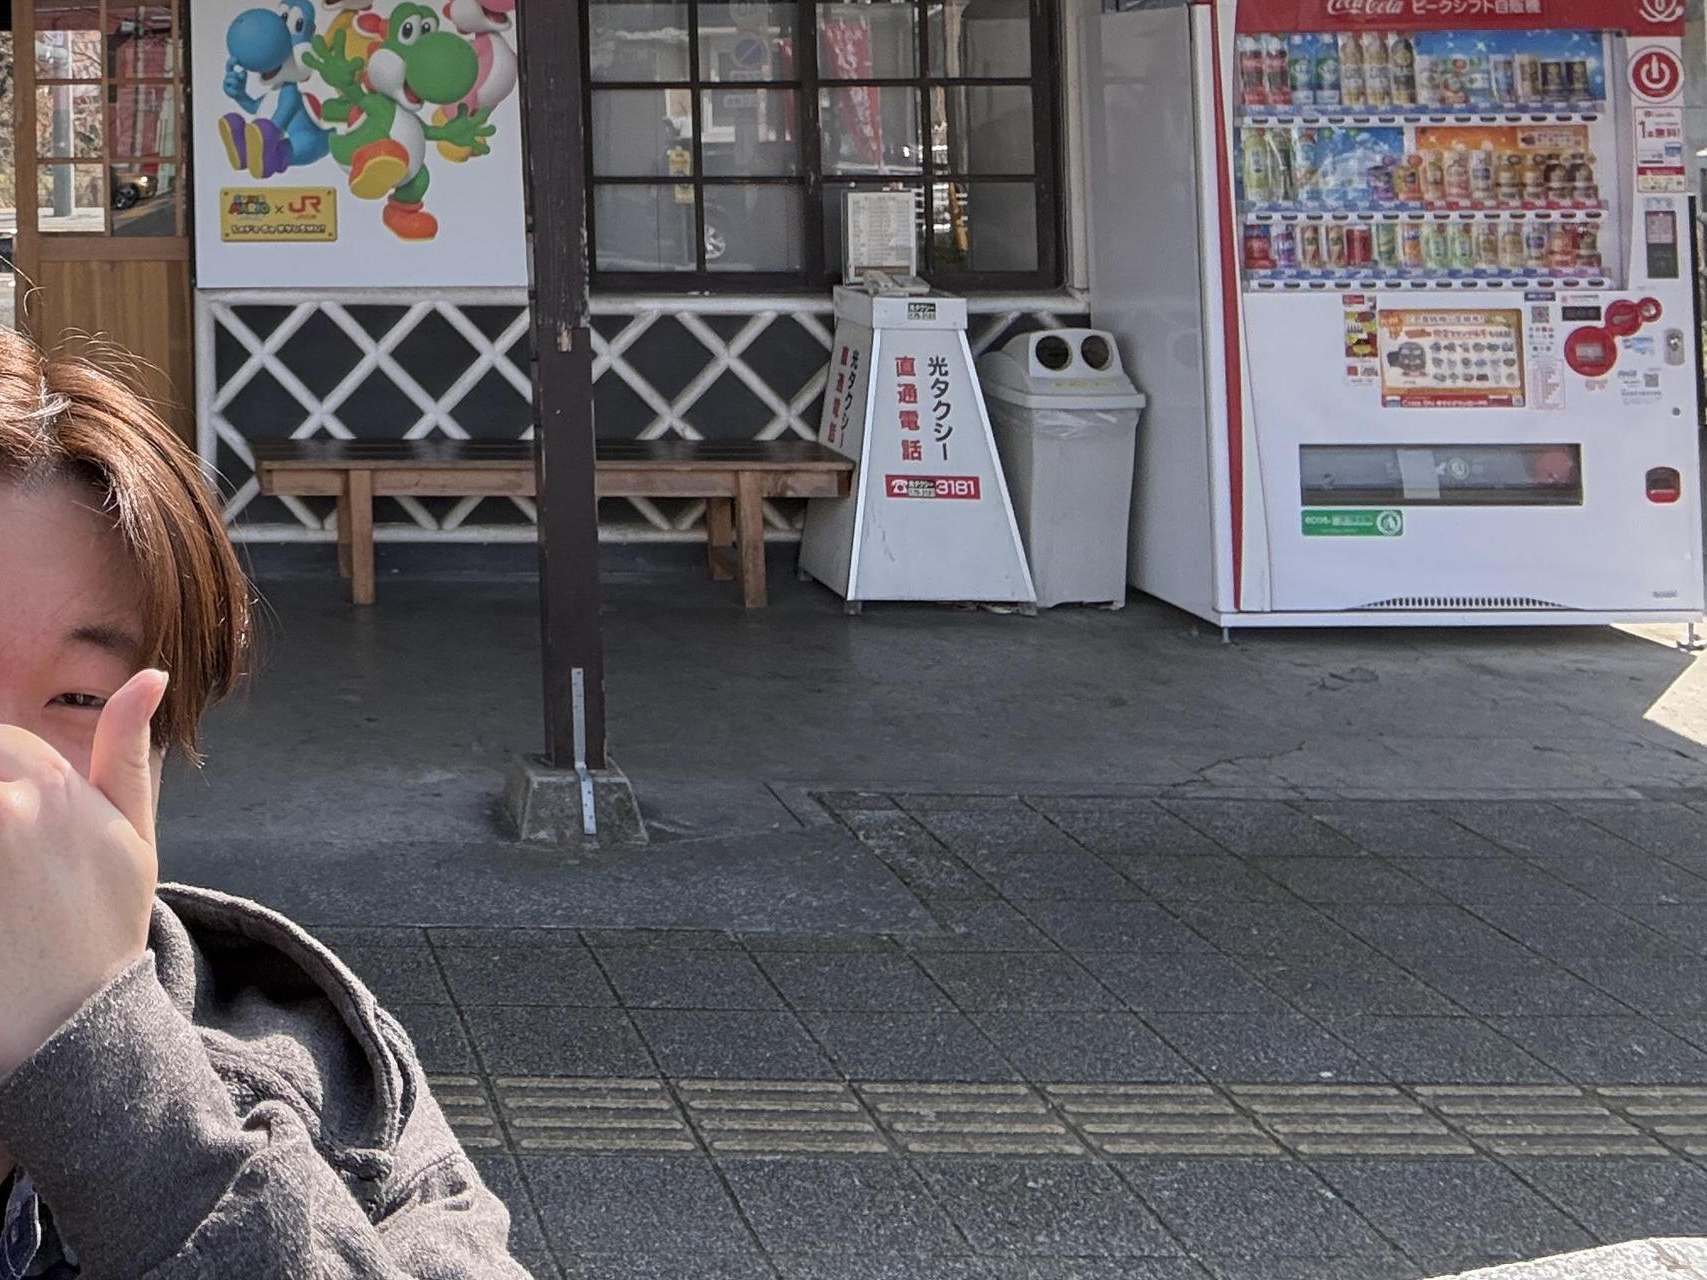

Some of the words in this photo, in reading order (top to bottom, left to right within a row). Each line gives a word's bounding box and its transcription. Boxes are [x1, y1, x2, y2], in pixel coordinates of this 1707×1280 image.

[288, 195, 321, 213] JR
[895, 355, 922, 461] 直通電話
[927, 355, 953, 461] 光タクシー
[936, 479, 975, 495] 3181
